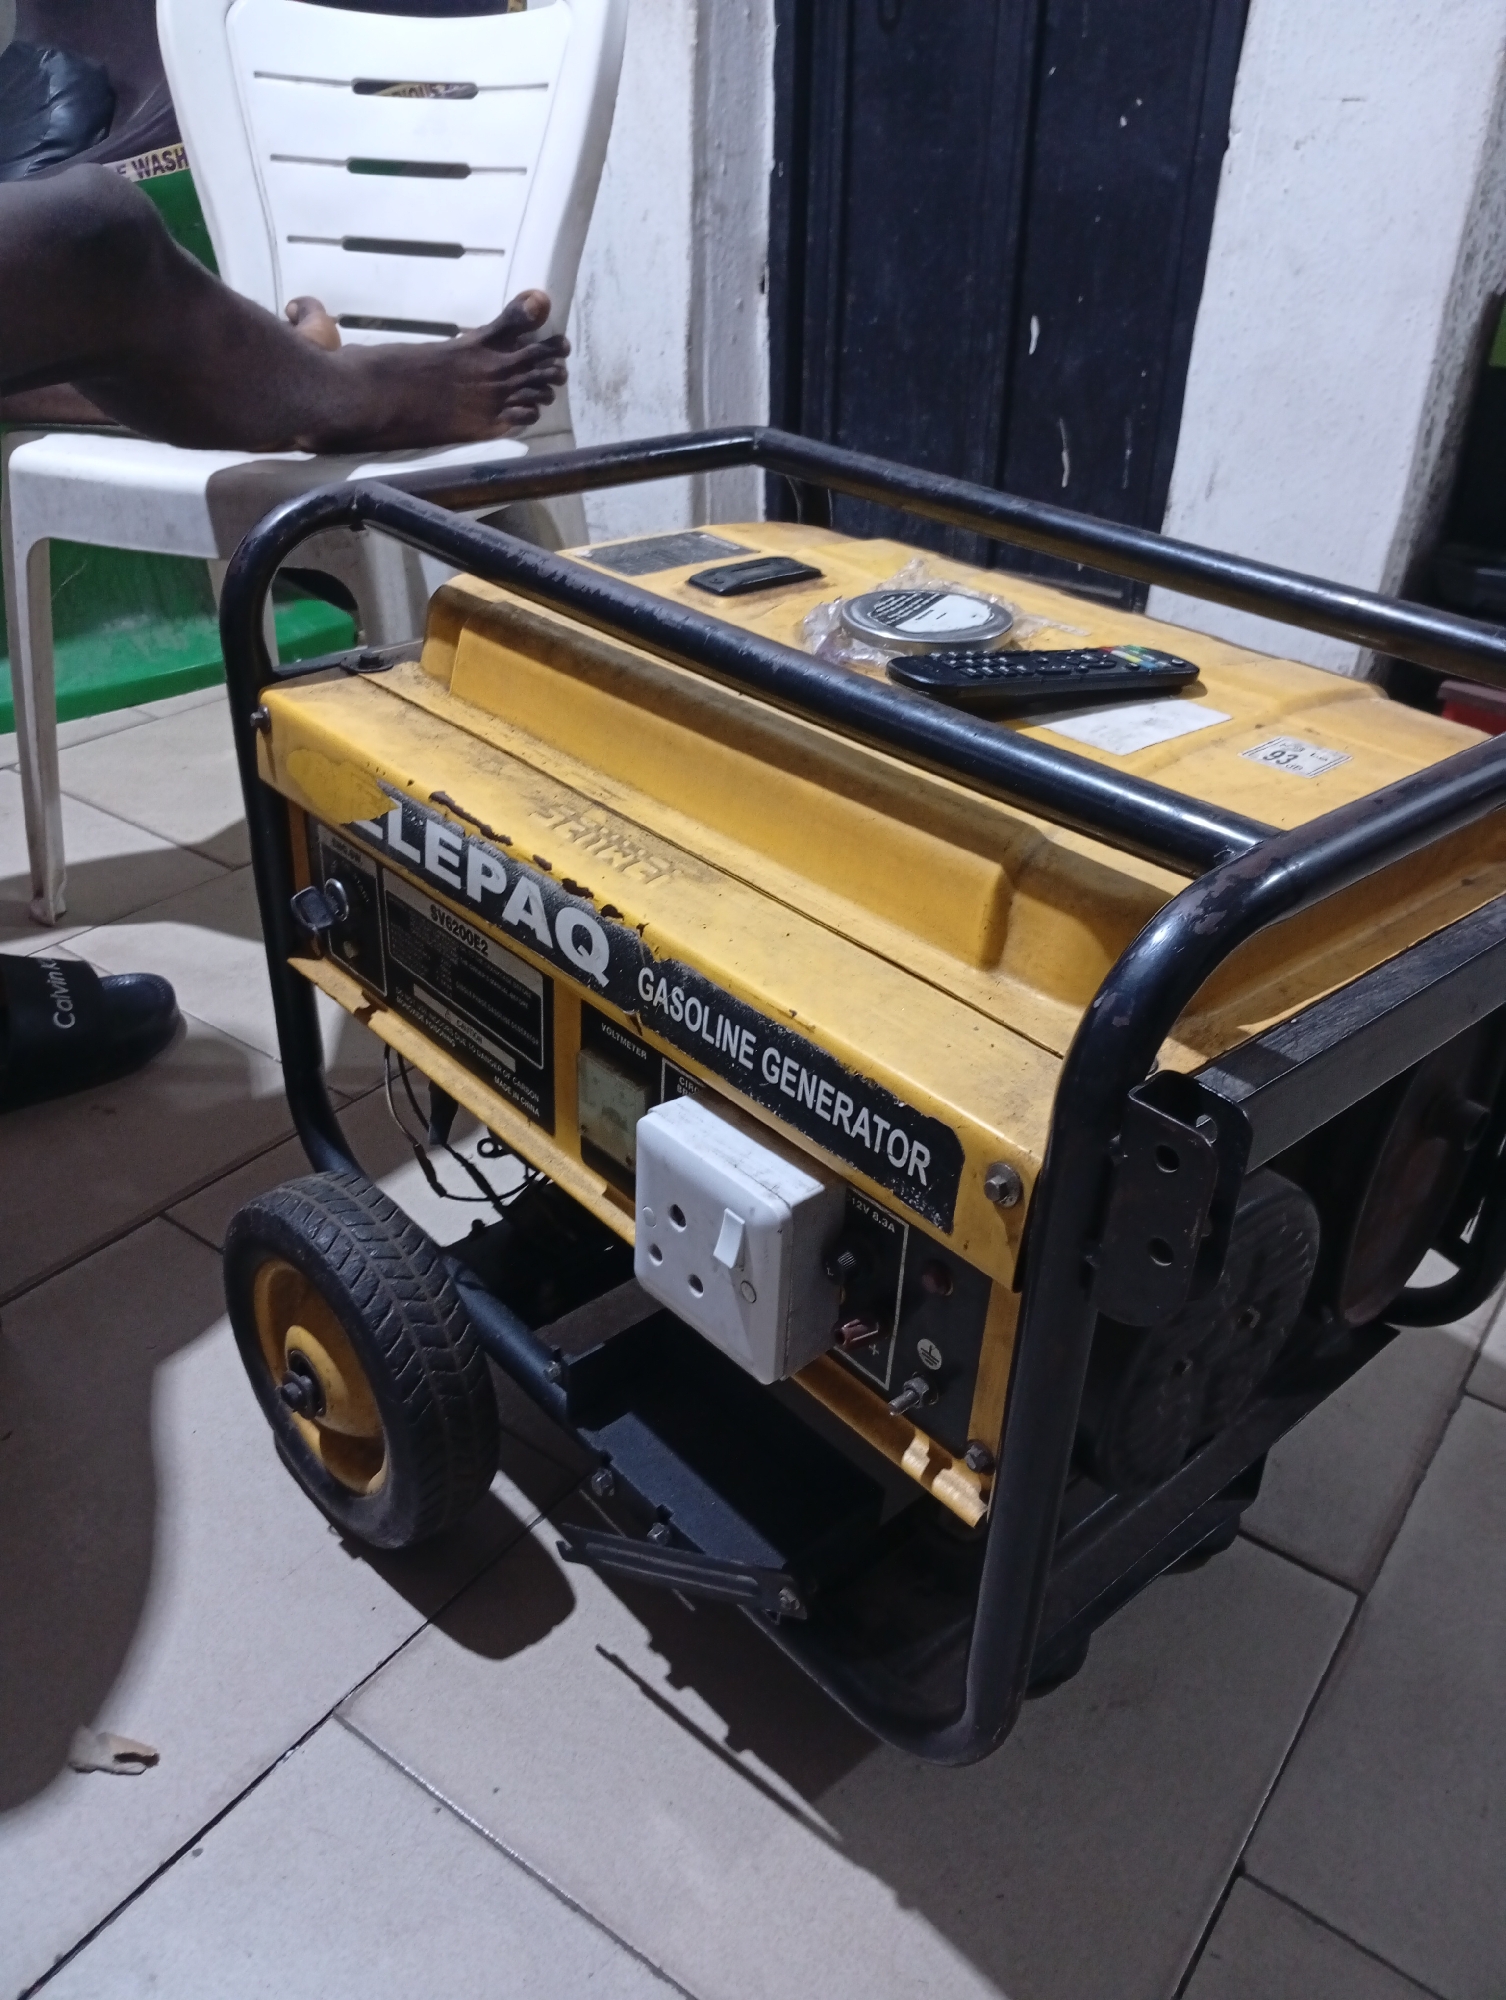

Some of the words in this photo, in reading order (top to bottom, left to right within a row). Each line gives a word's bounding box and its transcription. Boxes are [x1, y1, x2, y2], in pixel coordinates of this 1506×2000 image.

[131, 147, 189, 179] WASH
[1263, 750, 1298, 764] 93
[430, 904, 488, 956] SV6200E2
[46, 971, 76, 1029] Calvin
[601, 1022, 648, 1060] VOLTMETER
[494, 1074, 512, 1096] MADE
[520, 1094, 540, 1118] CHINA
[638, 966, 757, 1070] GASOLINE
[762, 1046, 932, 1186] GENERATOR
[872, 1211, 896, 1234] 8.3A
